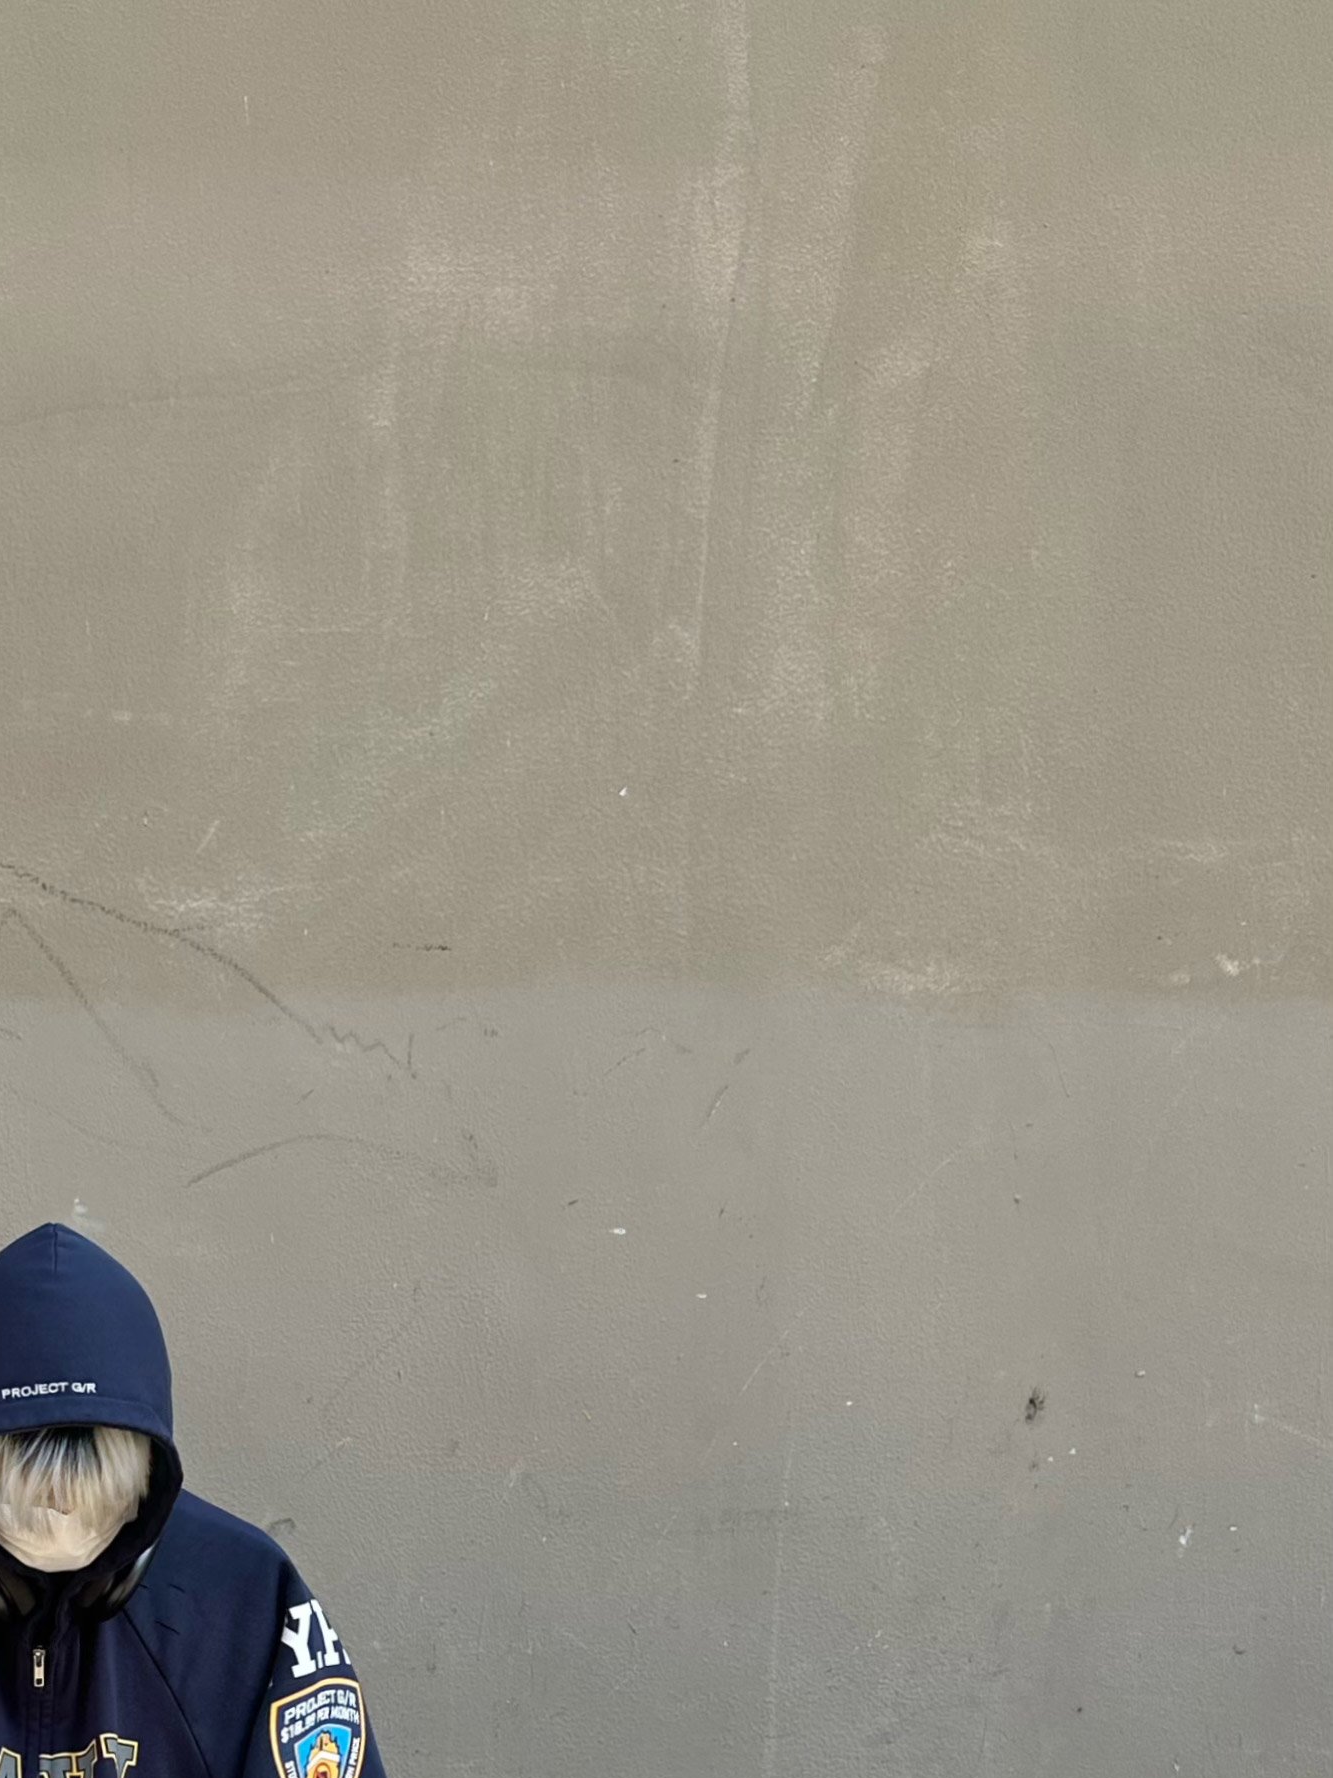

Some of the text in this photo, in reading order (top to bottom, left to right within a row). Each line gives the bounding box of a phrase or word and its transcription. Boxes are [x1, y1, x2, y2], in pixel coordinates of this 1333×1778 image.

[1, 1382, 68, 1399] PROJECT
[284, 1689, 336, 1725] PROJECT
[330, 1705, 360, 1725] MONTH
